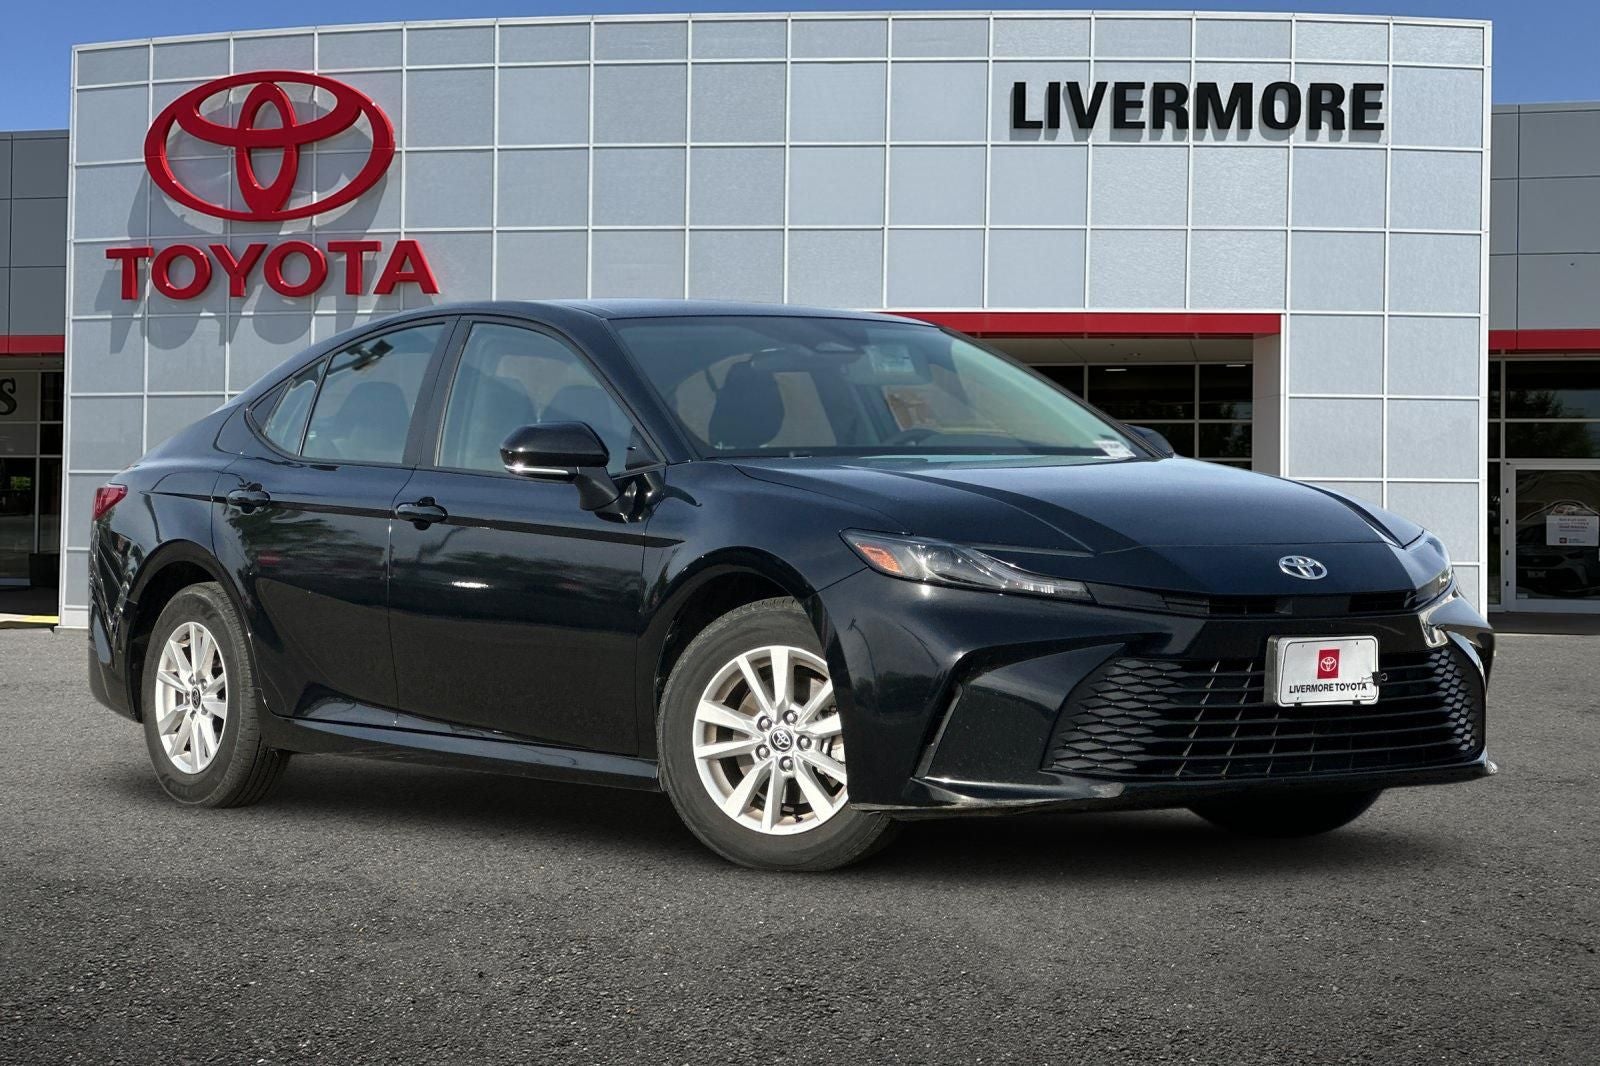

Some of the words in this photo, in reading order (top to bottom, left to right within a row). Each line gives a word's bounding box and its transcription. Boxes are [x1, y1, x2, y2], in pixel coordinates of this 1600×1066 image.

[1012, 81, 1385, 131] LIVERMORE
[106, 240, 440, 300] TOYOTA
[1289, 684, 1333, 694] LIVERMORE
[1335, 682, 1368, 691] TOYOTA
